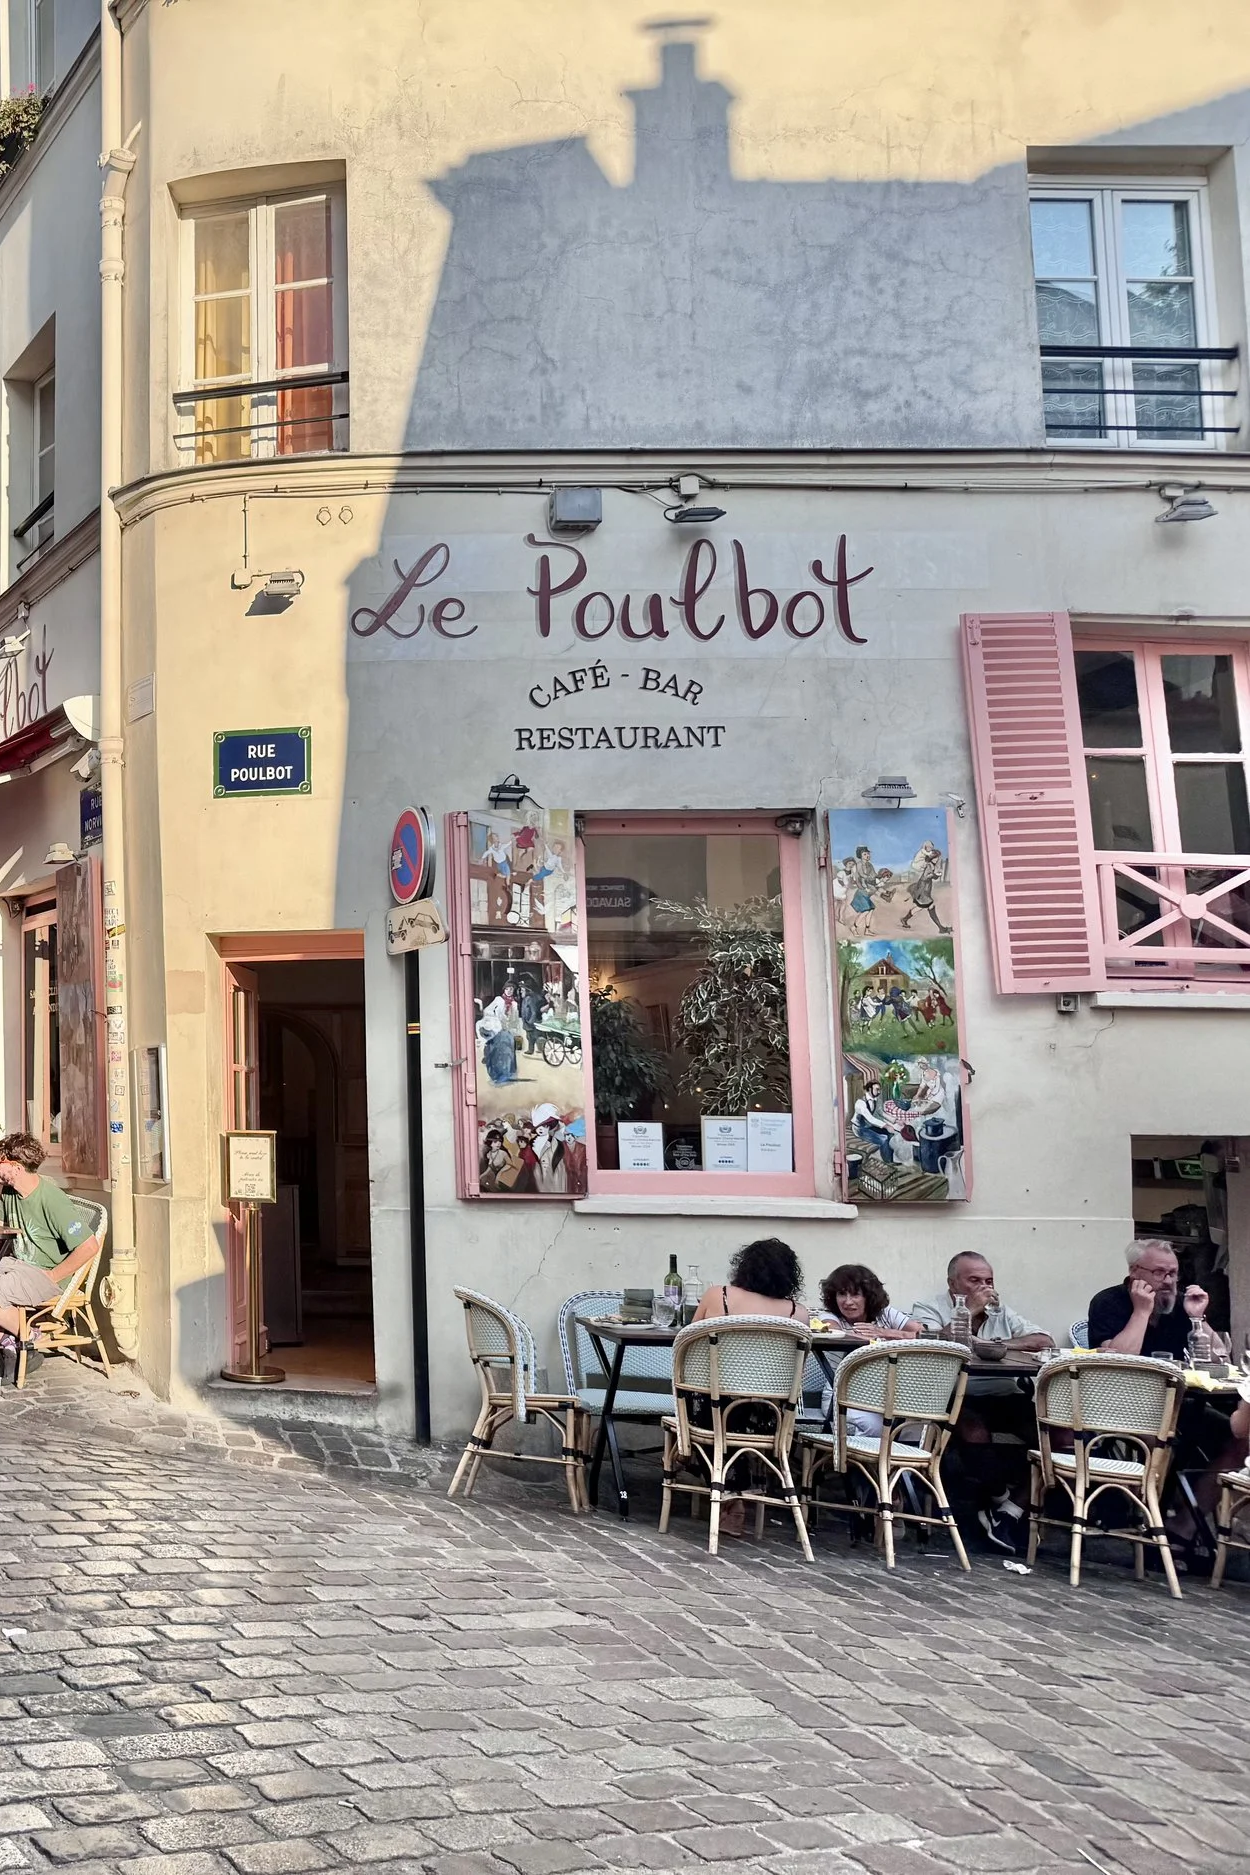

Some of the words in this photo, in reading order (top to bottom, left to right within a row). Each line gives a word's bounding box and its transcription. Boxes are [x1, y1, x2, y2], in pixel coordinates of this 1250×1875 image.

[351, 543, 478, 638] Le
[524, 533, 874, 643] Poulbot
[529, 659, 610, 709] CAFÉ
[639, 667, 703, 705] BAR
[248, 744, 276, 758] RUE
[514, 725, 726, 751] RESTAURANT
[231, 766, 293, 782] POULBOT
